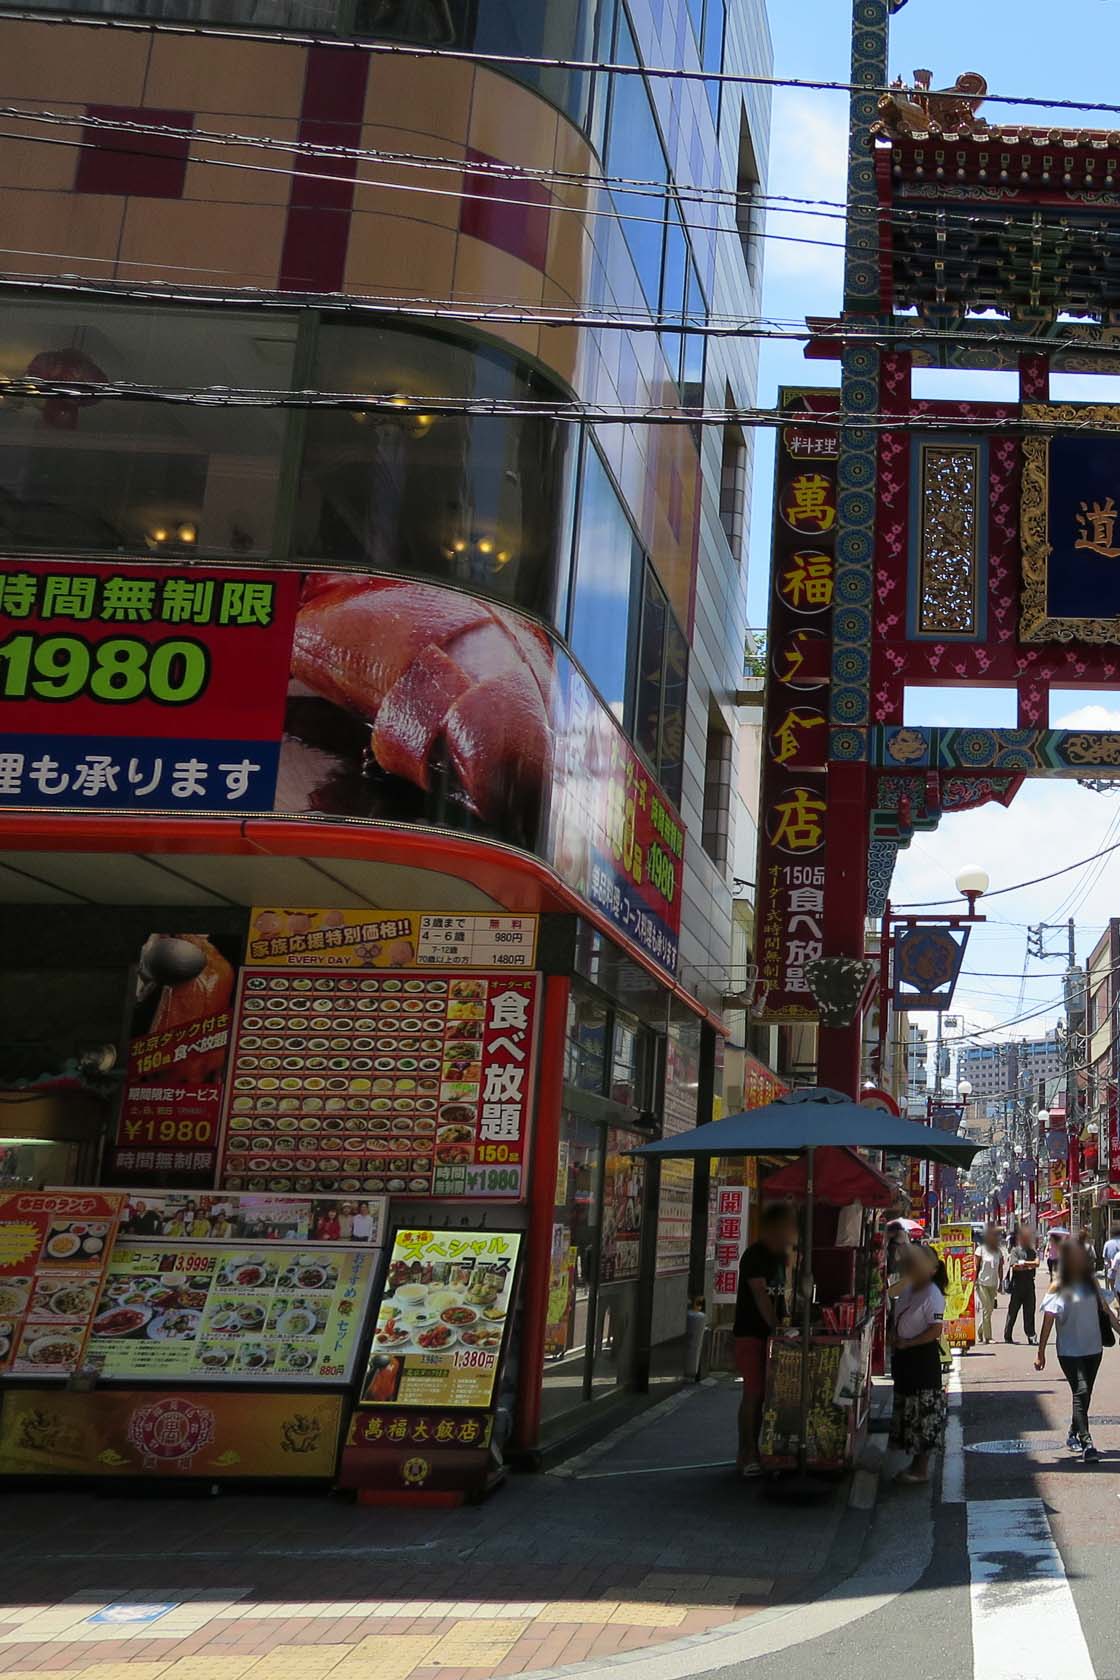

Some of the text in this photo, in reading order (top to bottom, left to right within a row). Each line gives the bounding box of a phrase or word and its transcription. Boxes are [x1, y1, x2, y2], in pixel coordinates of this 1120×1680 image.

[790, 436, 838, 454] 料理
[494, 932, 523, 943] 980円
[287, 955, 351, 965] EVERY DAY
[492, 954, 525, 965] 1480円
[479, 990, 531, 1142] 食べ放題
[125, 1119, 211, 1143] ¥1980
[116, 1151, 213, 1170] 時間無制限
[18, 1196, 96, 1212] 本日のランチ
[402, 1237, 510, 1260] スペシャル
[713, 1190, 743, 1295] 開運手相
[133, 1252, 160, 1263] コース
[459, 1257, 512, 1273] コース
[452, 1351, 495, 1369] 1,380円
[319, 1364, 345, 1376] 880円
[363, 1417, 480, 1442] 萬福大飯店
